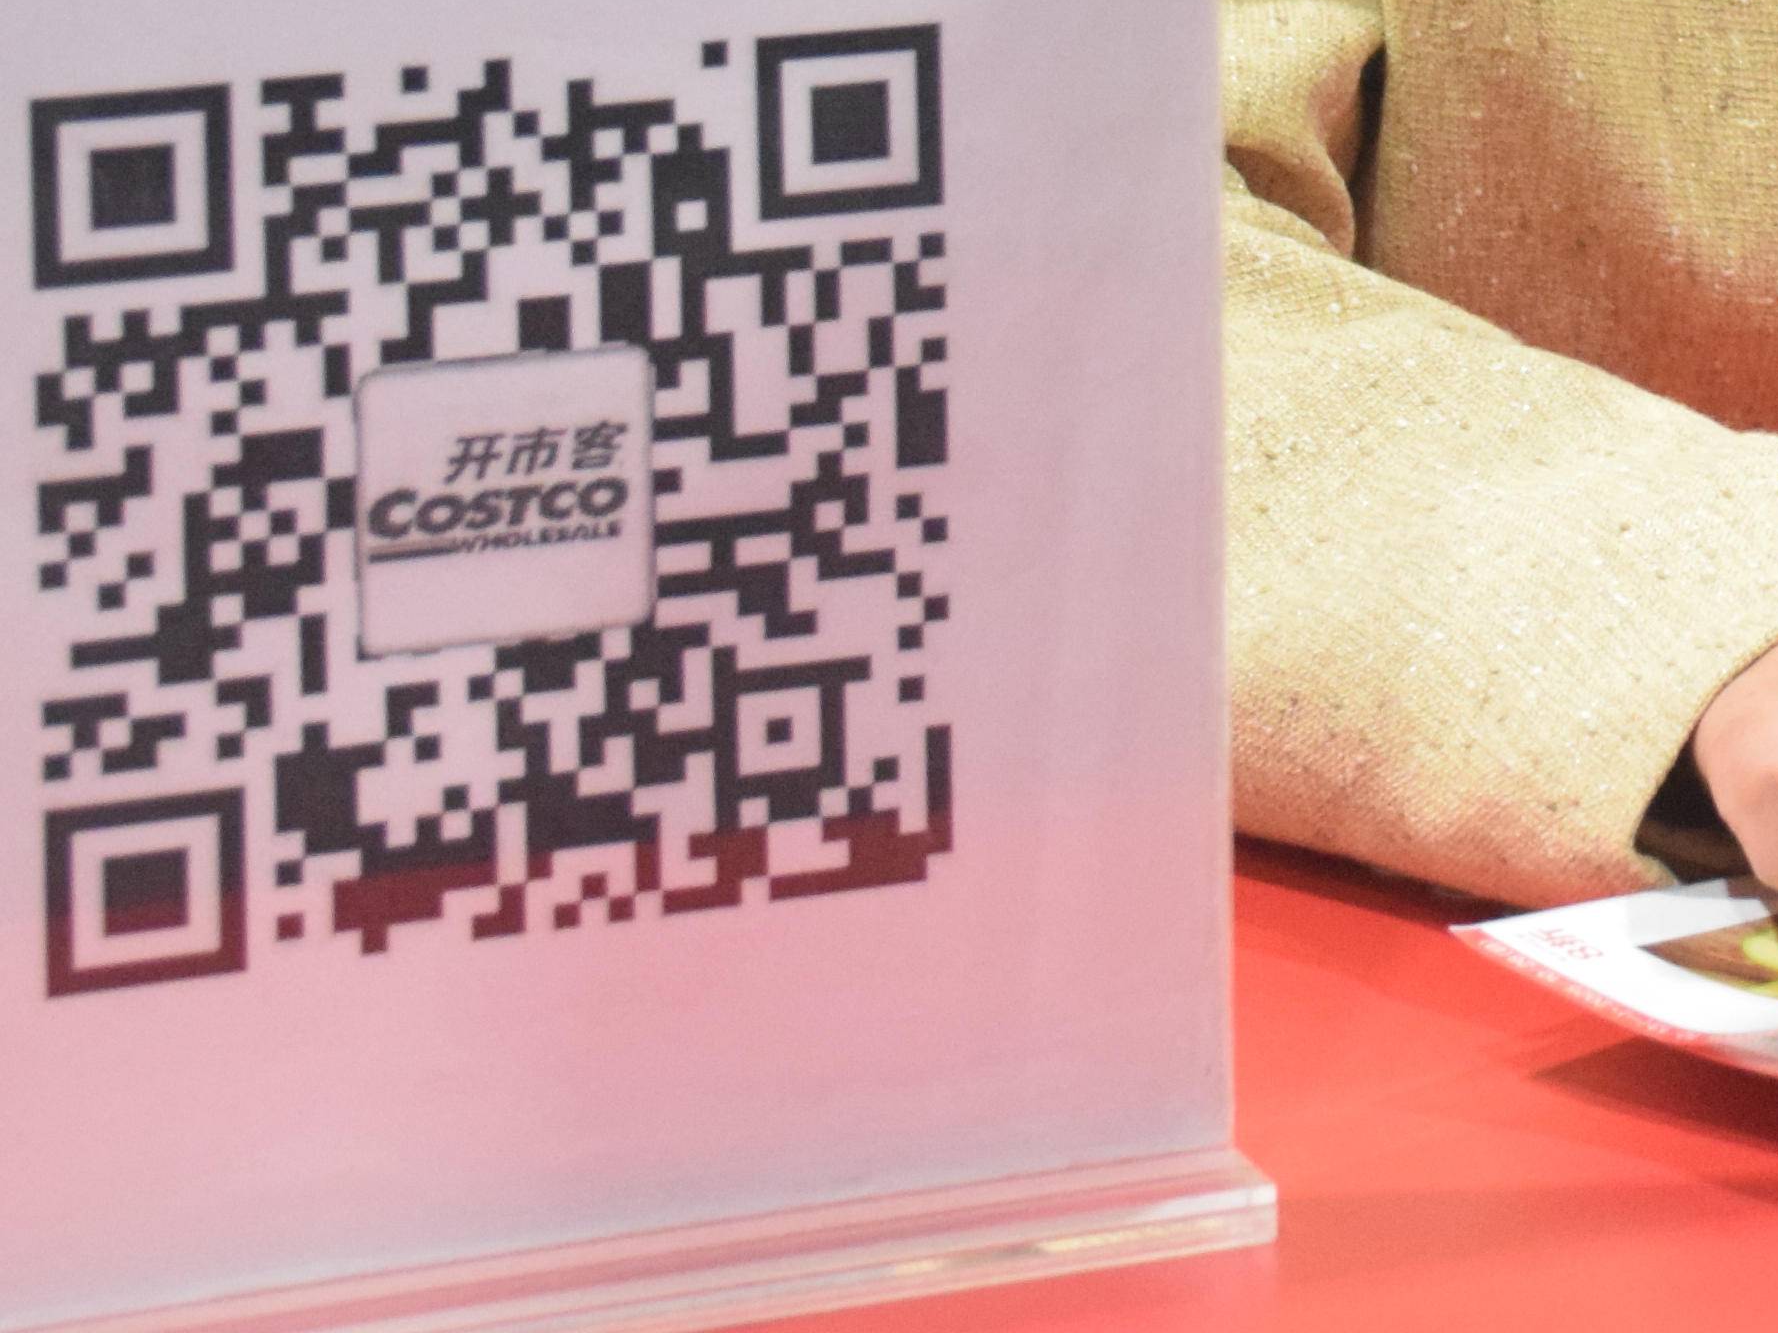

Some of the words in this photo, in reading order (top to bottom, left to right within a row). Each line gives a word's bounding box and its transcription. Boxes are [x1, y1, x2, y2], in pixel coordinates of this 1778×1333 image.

[443, 419, 629, 484] 开市客
[367, 475, 630, 540] COSTCO
